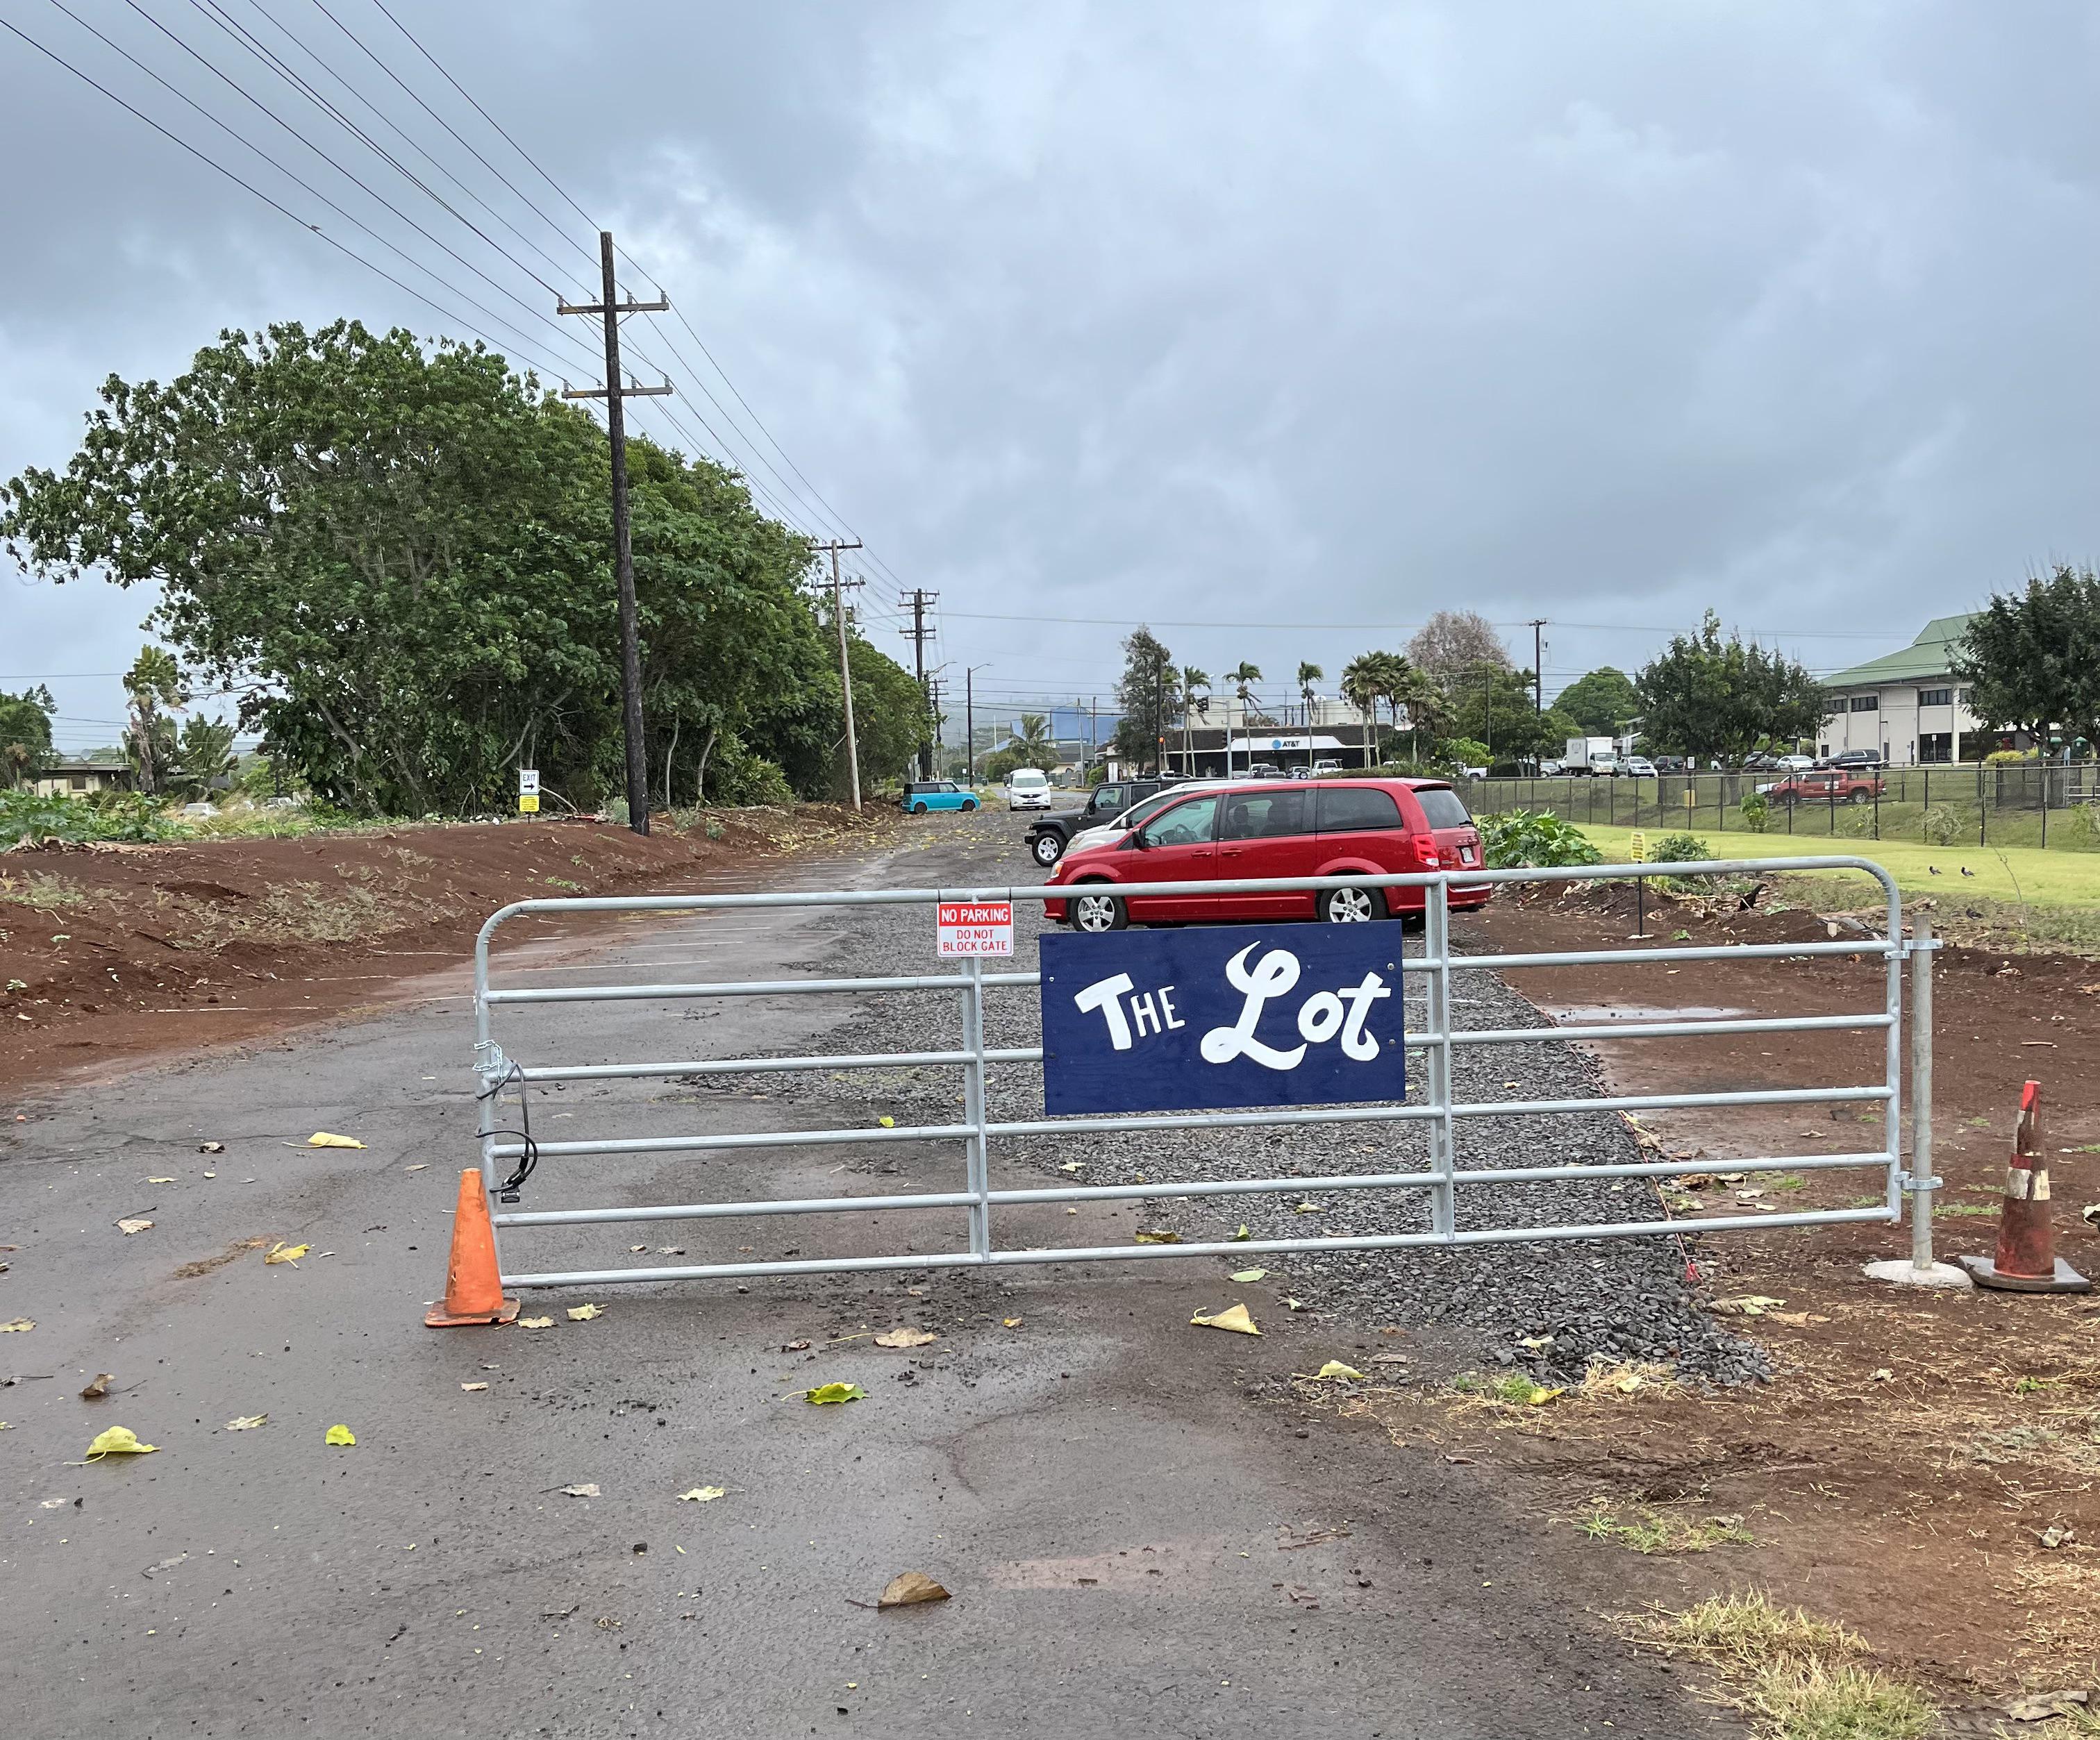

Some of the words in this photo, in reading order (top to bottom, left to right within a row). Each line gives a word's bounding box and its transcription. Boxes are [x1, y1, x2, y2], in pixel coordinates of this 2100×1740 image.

[941, 908, 958, 923] NO
[960, 907, 1009, 923] PARKING
[956, 930, 971, 939] DO
[974, 929, 994, 939] NOT
[943, 942, 978, 952] BLOCK
[981, 941, 1008, 951] GATE
[1074, 972, 1185, 1050] THE
[1200, 940, 1392, 1071] Lot
